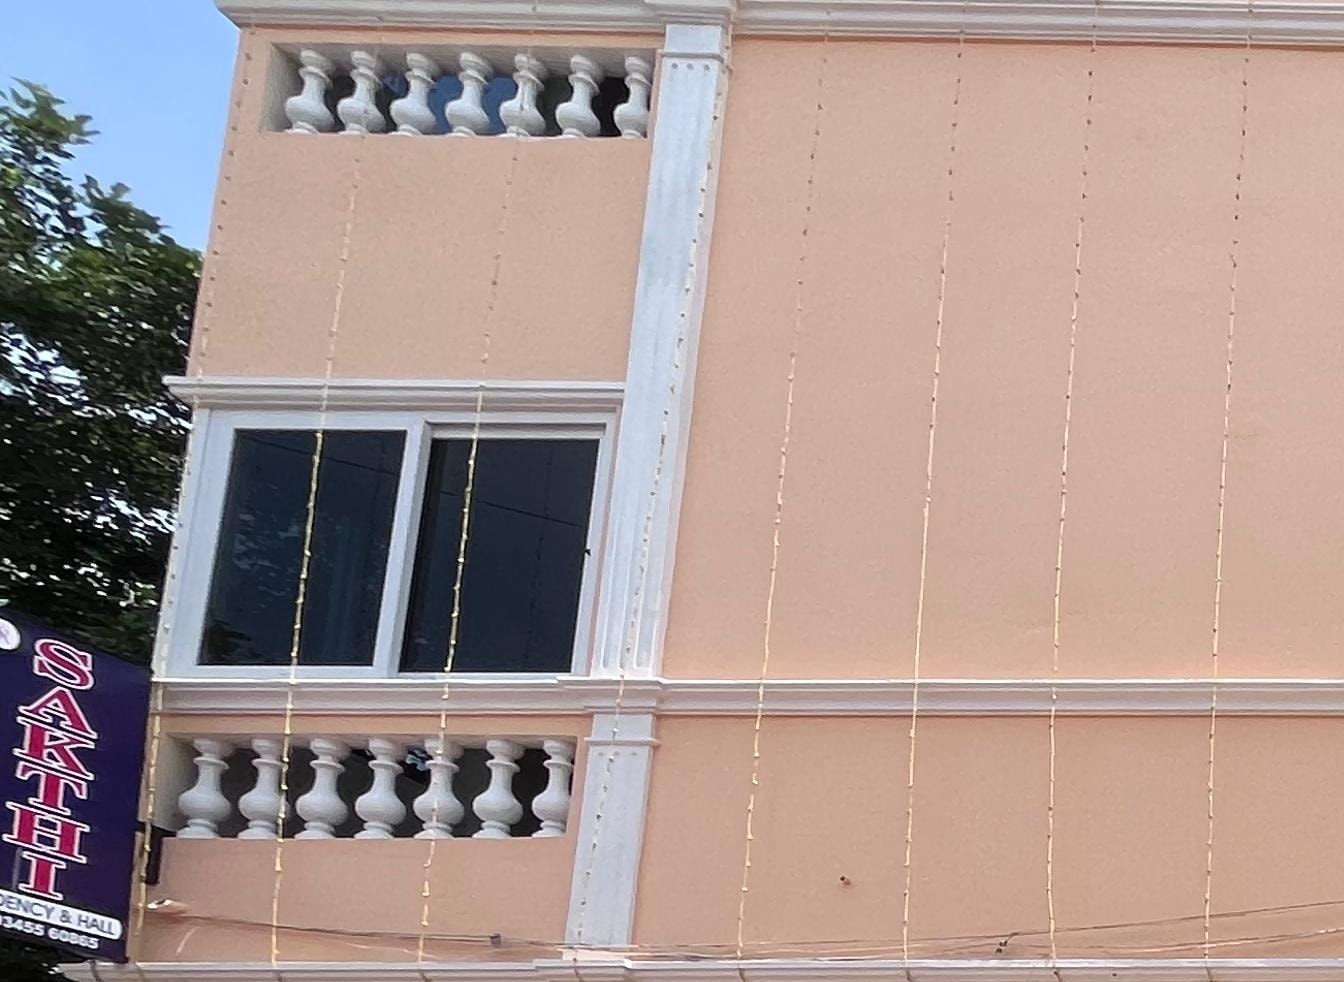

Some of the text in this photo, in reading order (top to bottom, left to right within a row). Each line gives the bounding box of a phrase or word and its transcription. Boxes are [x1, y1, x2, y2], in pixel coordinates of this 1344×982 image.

[2, 638, 98, 901] SAKTHI
[60, 909, 73, 924] &
[77, 913, 115, 936] HALL
